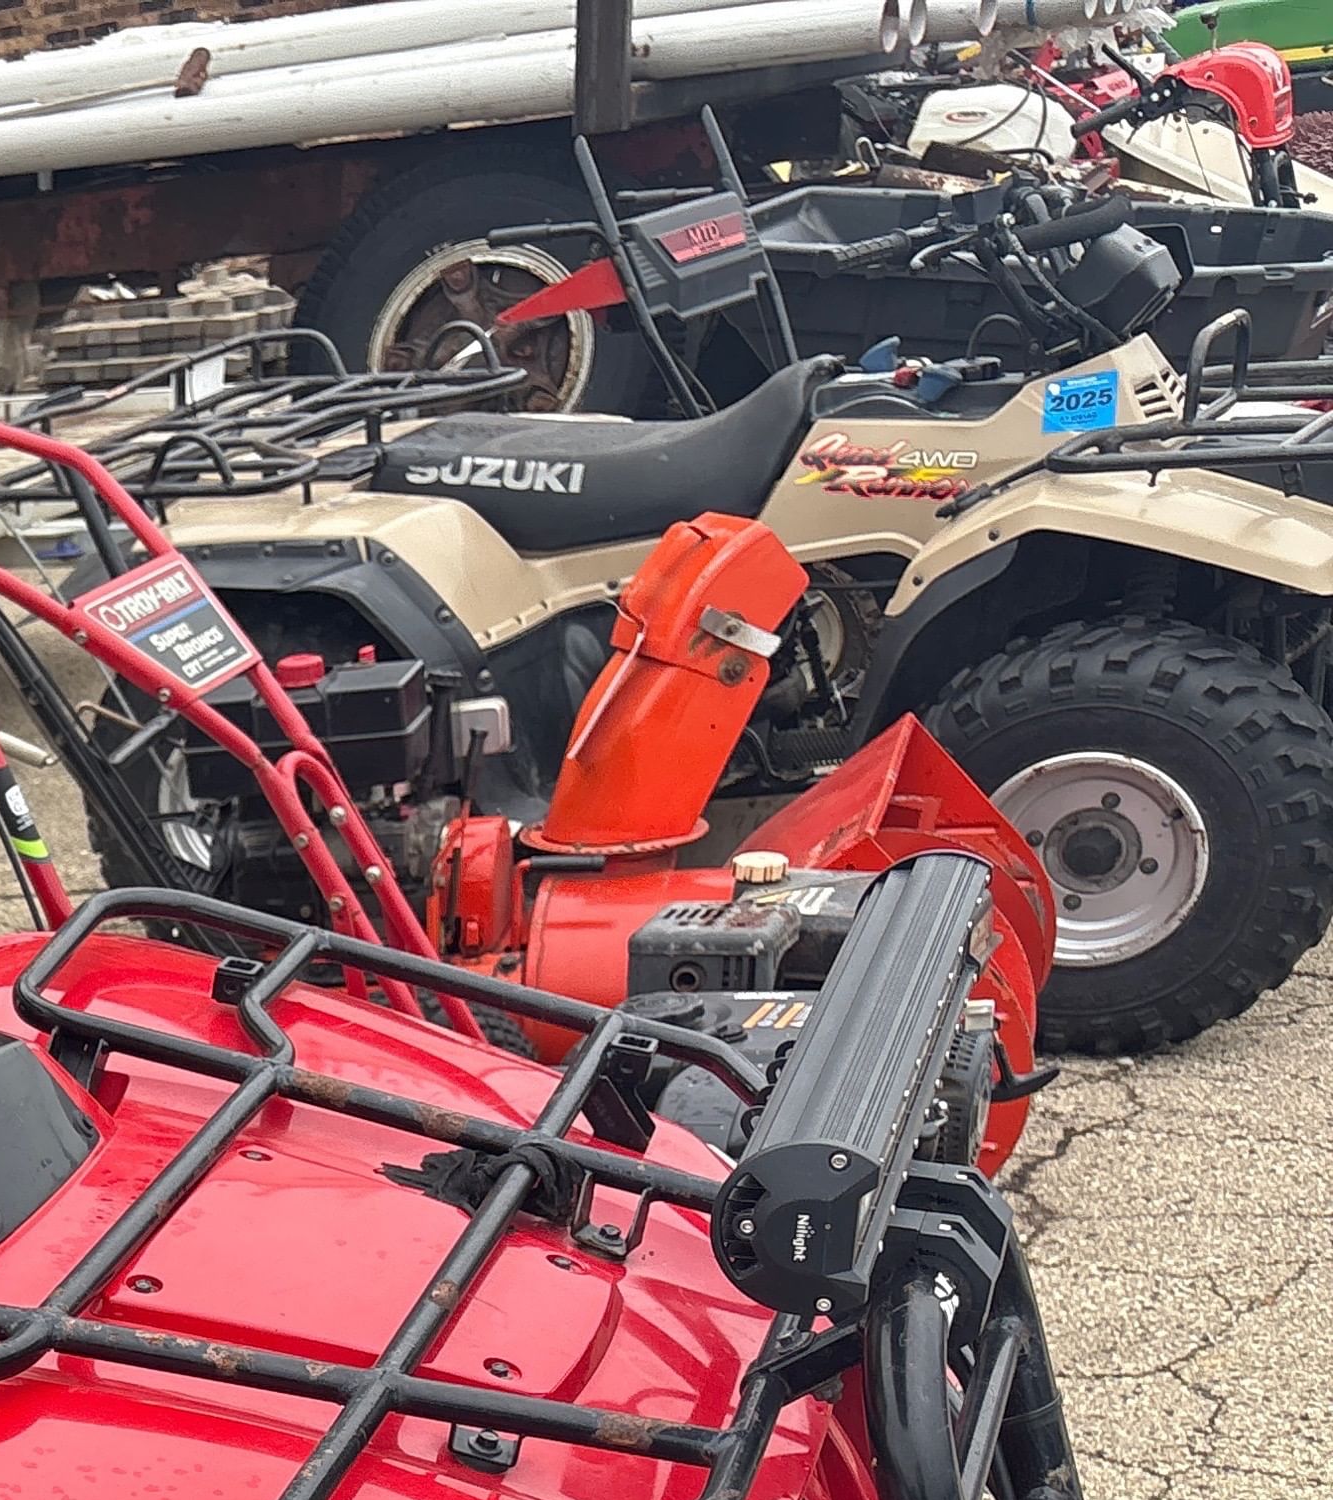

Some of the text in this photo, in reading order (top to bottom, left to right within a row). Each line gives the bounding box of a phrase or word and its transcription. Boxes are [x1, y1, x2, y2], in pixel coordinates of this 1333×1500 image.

[1049, 387, 1113, 412] 2025
[404, 455, 586, 494] SUZUKI
[897, 450, 980, 470] 4WD
[113, 571, 193, 624] TROY-BILT
[792, 1214, 816, 1262] Nilight
